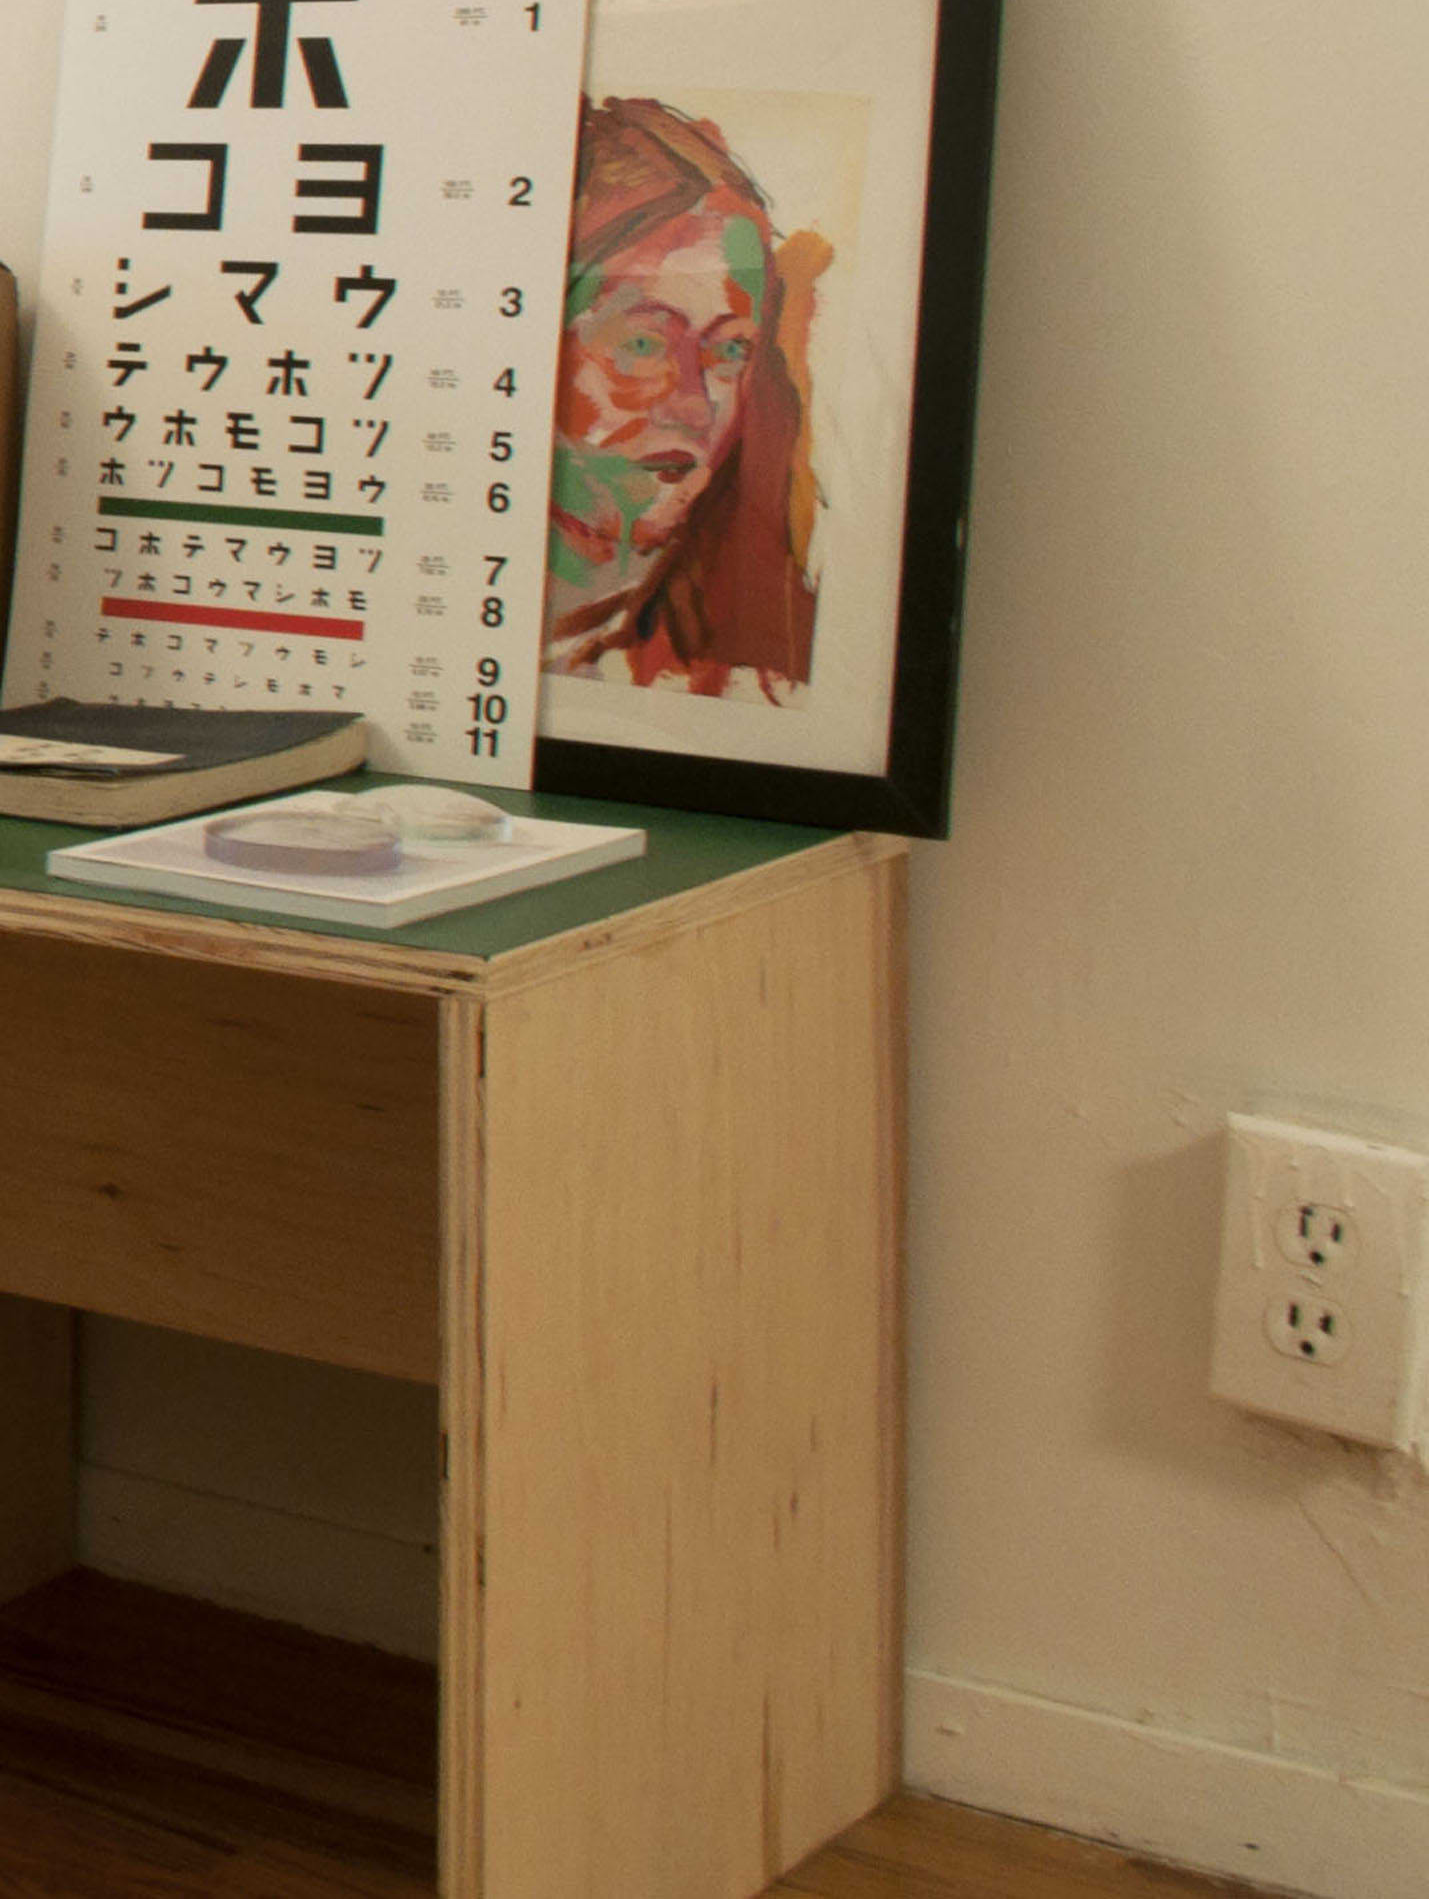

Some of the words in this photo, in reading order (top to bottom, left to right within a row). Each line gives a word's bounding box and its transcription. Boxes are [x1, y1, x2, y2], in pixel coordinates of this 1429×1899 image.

[524, 1, 541, 33] 1
[142, 142, 385, 235] コヨ
[508, 175, 534, 207] 2
[113, 258, 397, 329] シマウ
[499, 286, 523, 319] 3
[107, 342, 393, 400] テウホツ
[492, 367, 517, 399] 4
[102, 405, 389, 458] ウホモコツ
[488, 430, 513, 463] 5
[99, 457, 387, 504] ホツコモヨウ
[486, 481, 511, 514] 6
[483, 555, 508, 587] 7
[480, 595, 505, 629] 8
[476, 656, 501, 688] 9
[466, 692, 508, 725] 10
[465, 726, 499, 758] 11
